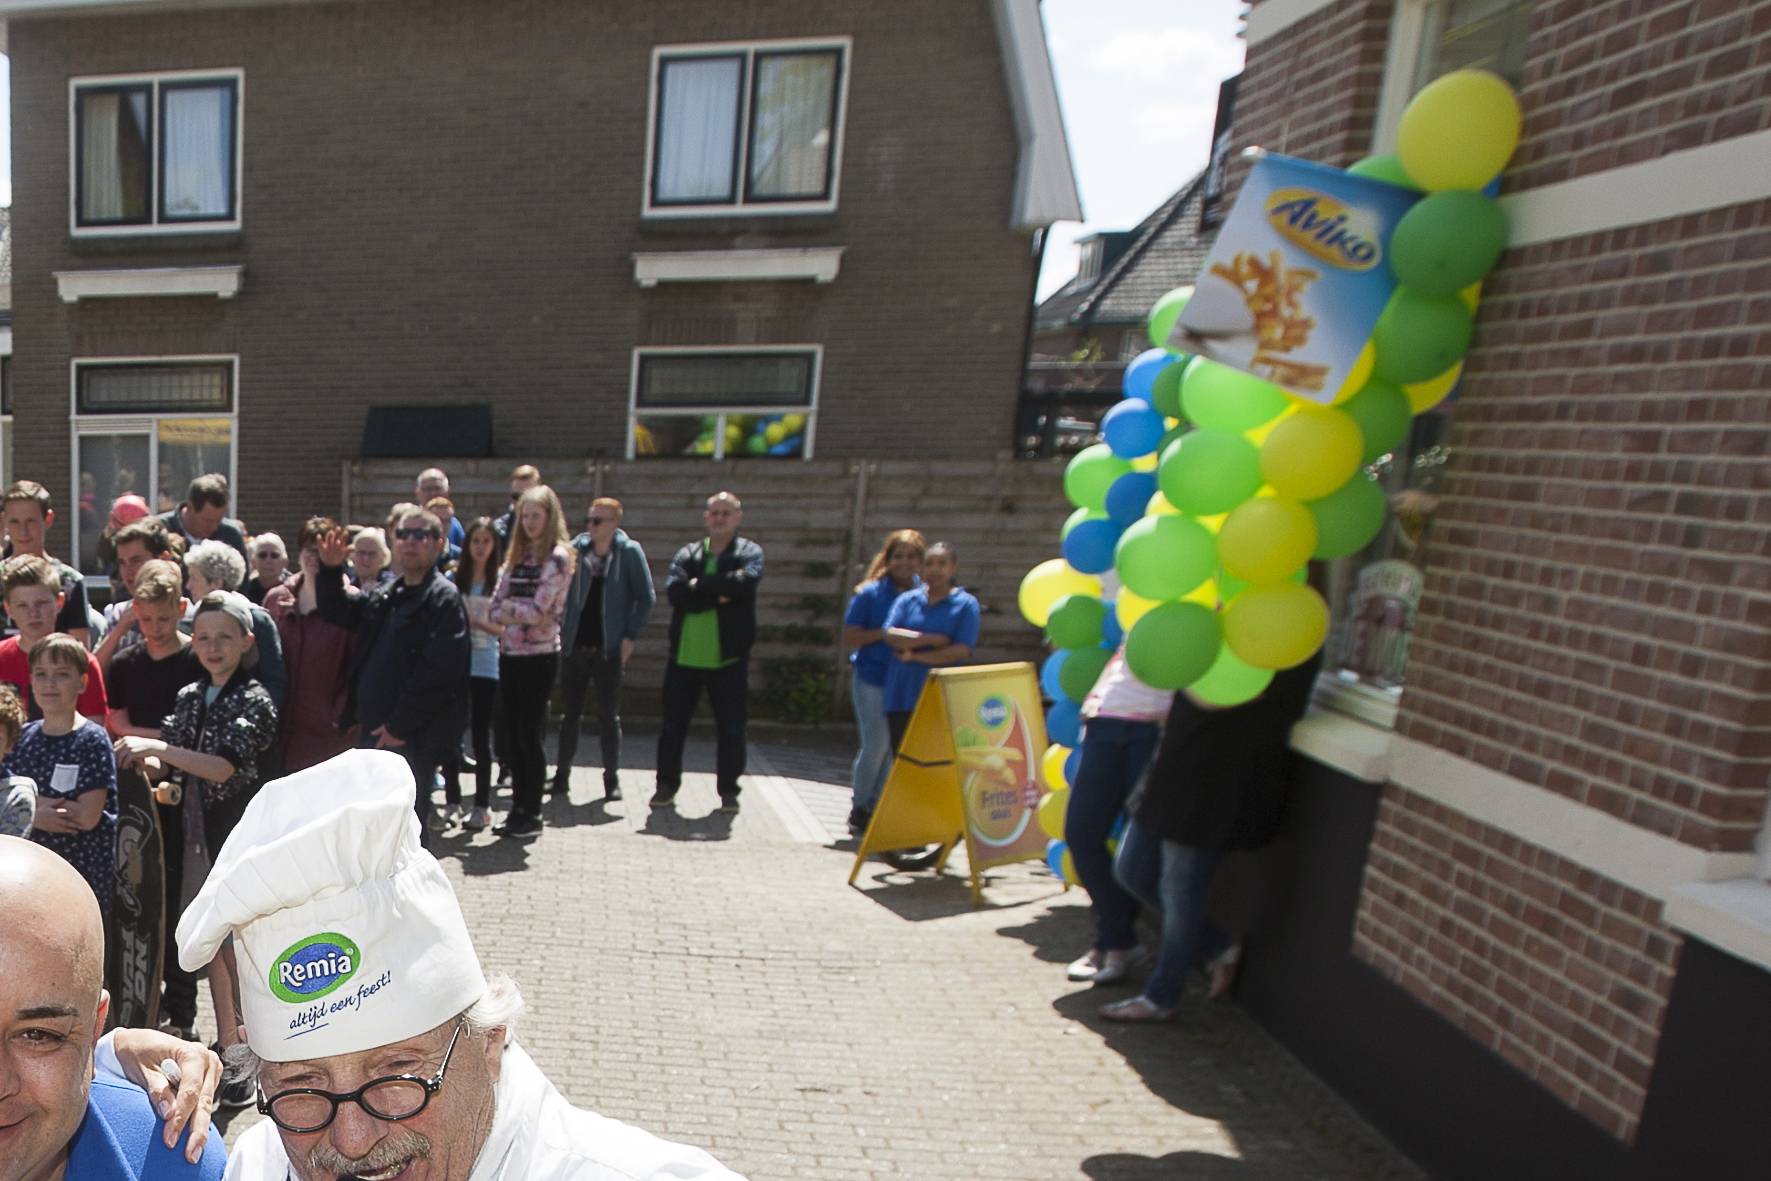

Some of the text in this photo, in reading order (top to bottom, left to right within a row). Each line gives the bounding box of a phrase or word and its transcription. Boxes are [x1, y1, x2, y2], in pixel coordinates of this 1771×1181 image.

[1269, 197, 1376, 262] Aviko
[982, 789, 1019, 808] Frites
[278, 952, 353, 989] Remia
[289, 970, 392, 1028] altijd een feest!
